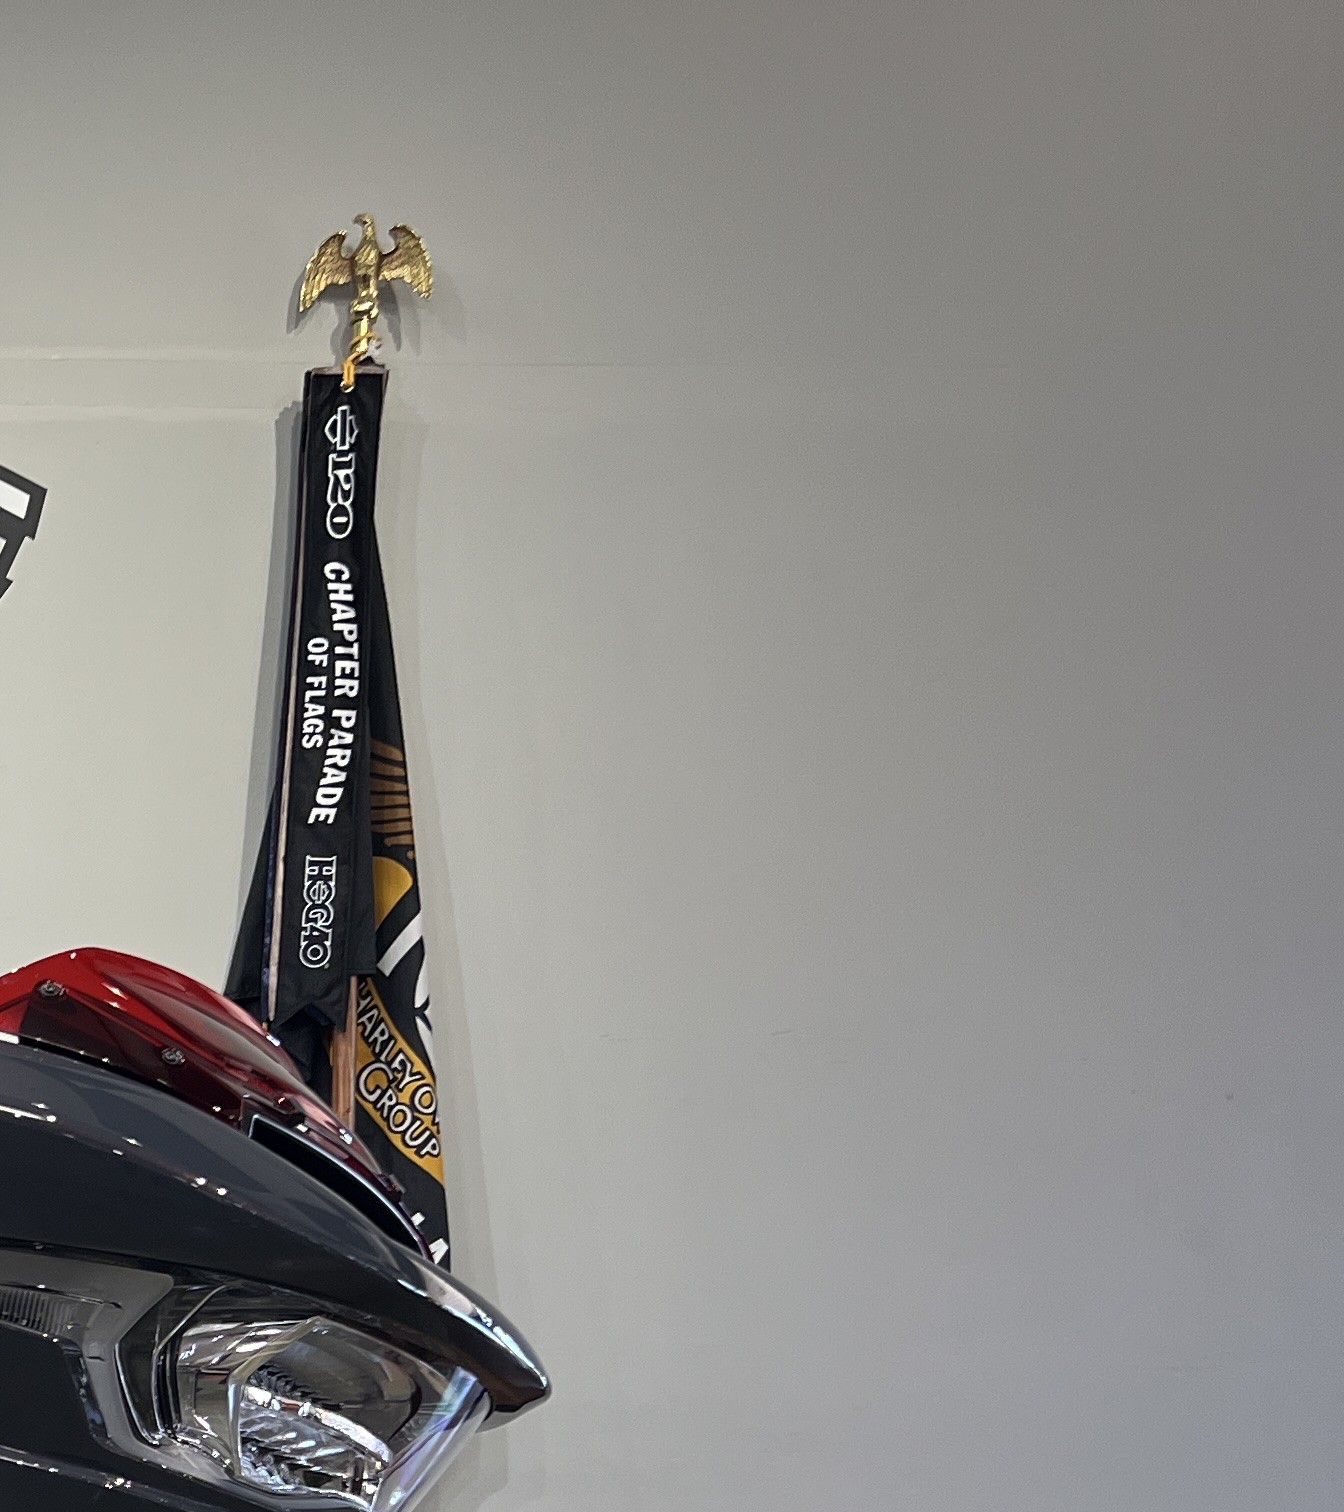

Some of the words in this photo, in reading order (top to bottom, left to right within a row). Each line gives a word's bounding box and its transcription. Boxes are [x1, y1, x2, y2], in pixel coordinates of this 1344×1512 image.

[326, 452, 357, 540] 120
[306, 637, 330, 667] OF
[323, 561, 360, 699] CHAPTER
[301, 676, 328, 750] FLAGS
[306, 708, 357, 825] PARADE
[357, 1061, 441, 1157] GROUP
